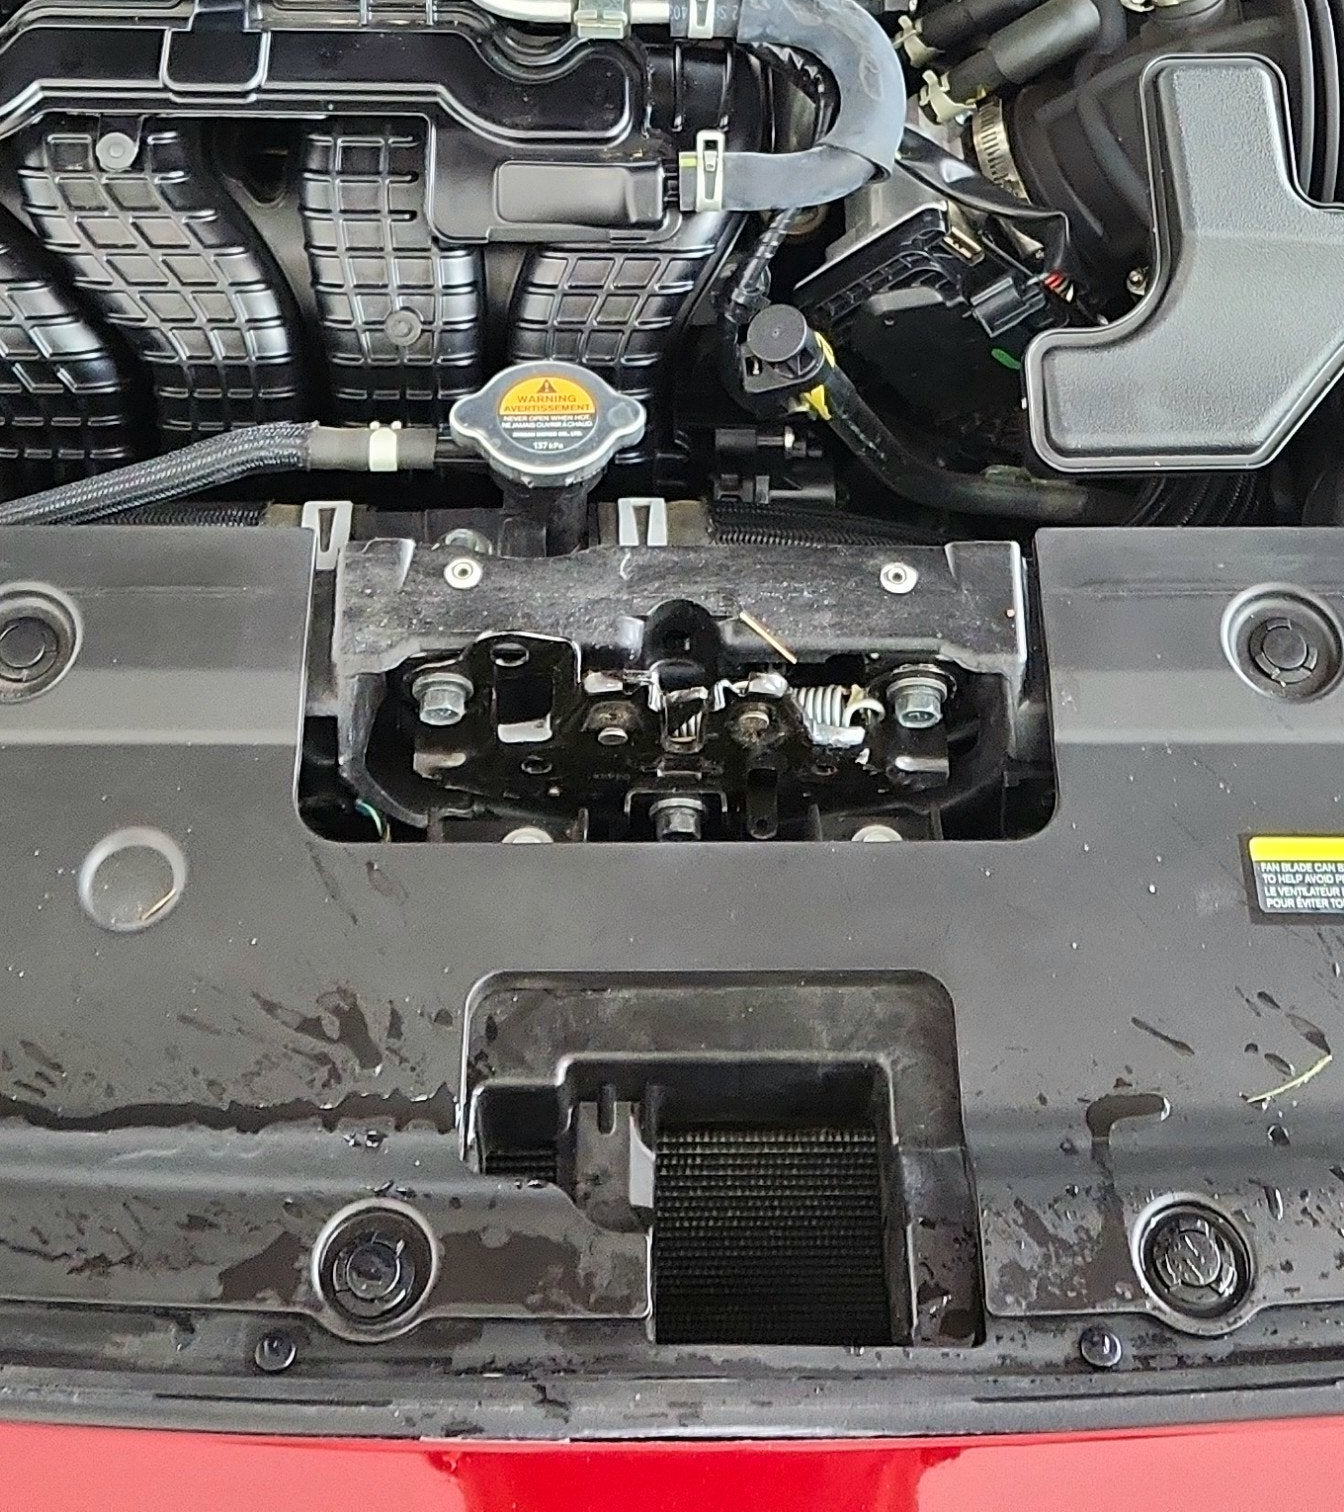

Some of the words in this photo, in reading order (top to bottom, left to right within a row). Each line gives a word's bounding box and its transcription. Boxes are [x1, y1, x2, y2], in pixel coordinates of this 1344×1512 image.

[518, 394, 576, 403] WARNING
[504, 404, 590, 412] AVERTISSEMENT
[533, 442, 548, 450] 137
[1260, 862, 1280, 872] FAN
[1282, 862, 1314, 872] BLADE
[1314, 862, 1336, 872] CAN
[1262, 874, 1276, 884] TO
[1278, 874, 1303, 884] HELP
[1306, 874, 1334, 884] AVOID
[1264, 887, 1276, 896] LE
[1278, 887, 1340, 897] VENTILATEUR
[1266, 898, 1295, 908] POUR
[1296, 896, 1329, 908] ÉVITER
